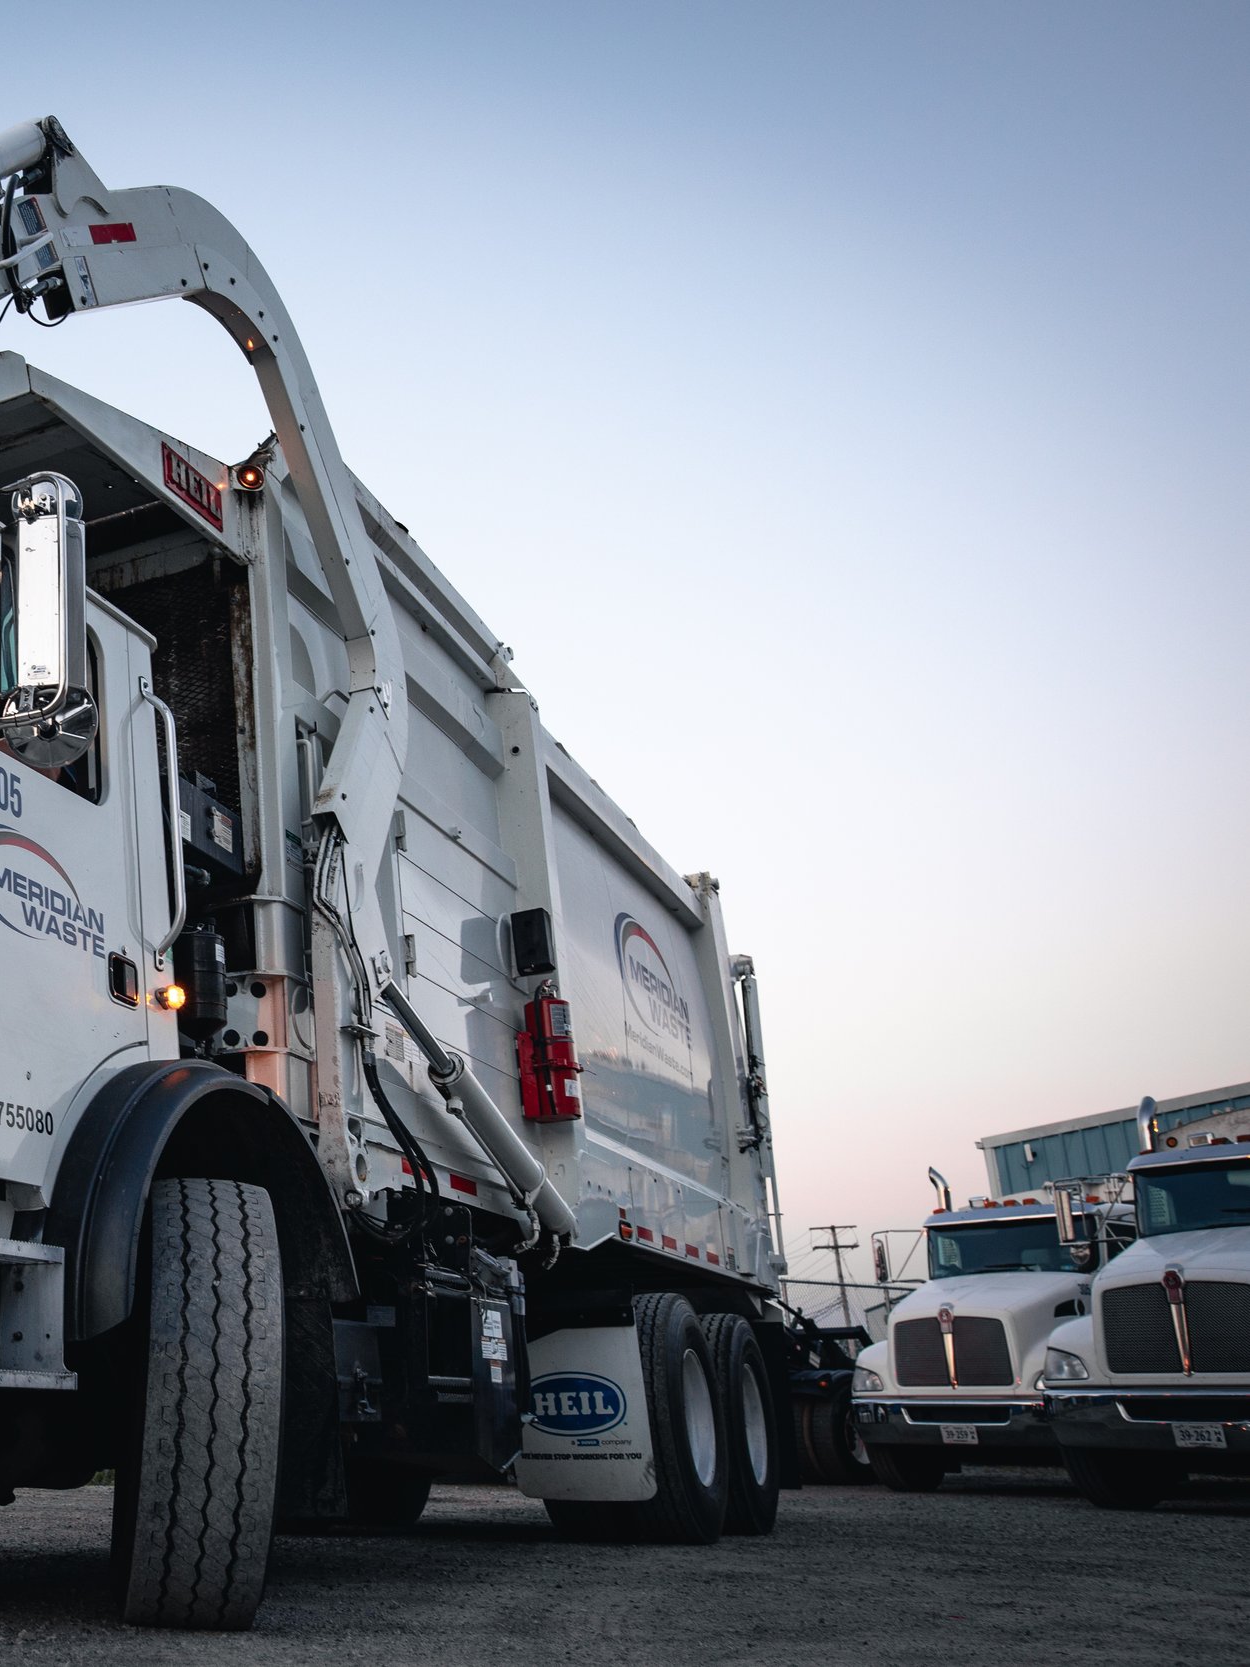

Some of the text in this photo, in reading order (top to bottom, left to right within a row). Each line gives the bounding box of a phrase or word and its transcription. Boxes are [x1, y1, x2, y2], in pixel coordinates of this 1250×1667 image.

[21, 901, 106, 959] WASTE
[629, 954, 690, 1025] MERIDIAN
[648, 996, 692, 1051] WASTE
[533, 1391, 615, 1416] HEIL
[1179, 1430, 1212, 1441] 39-262
[625, 1452, 642, 1460] YOU
